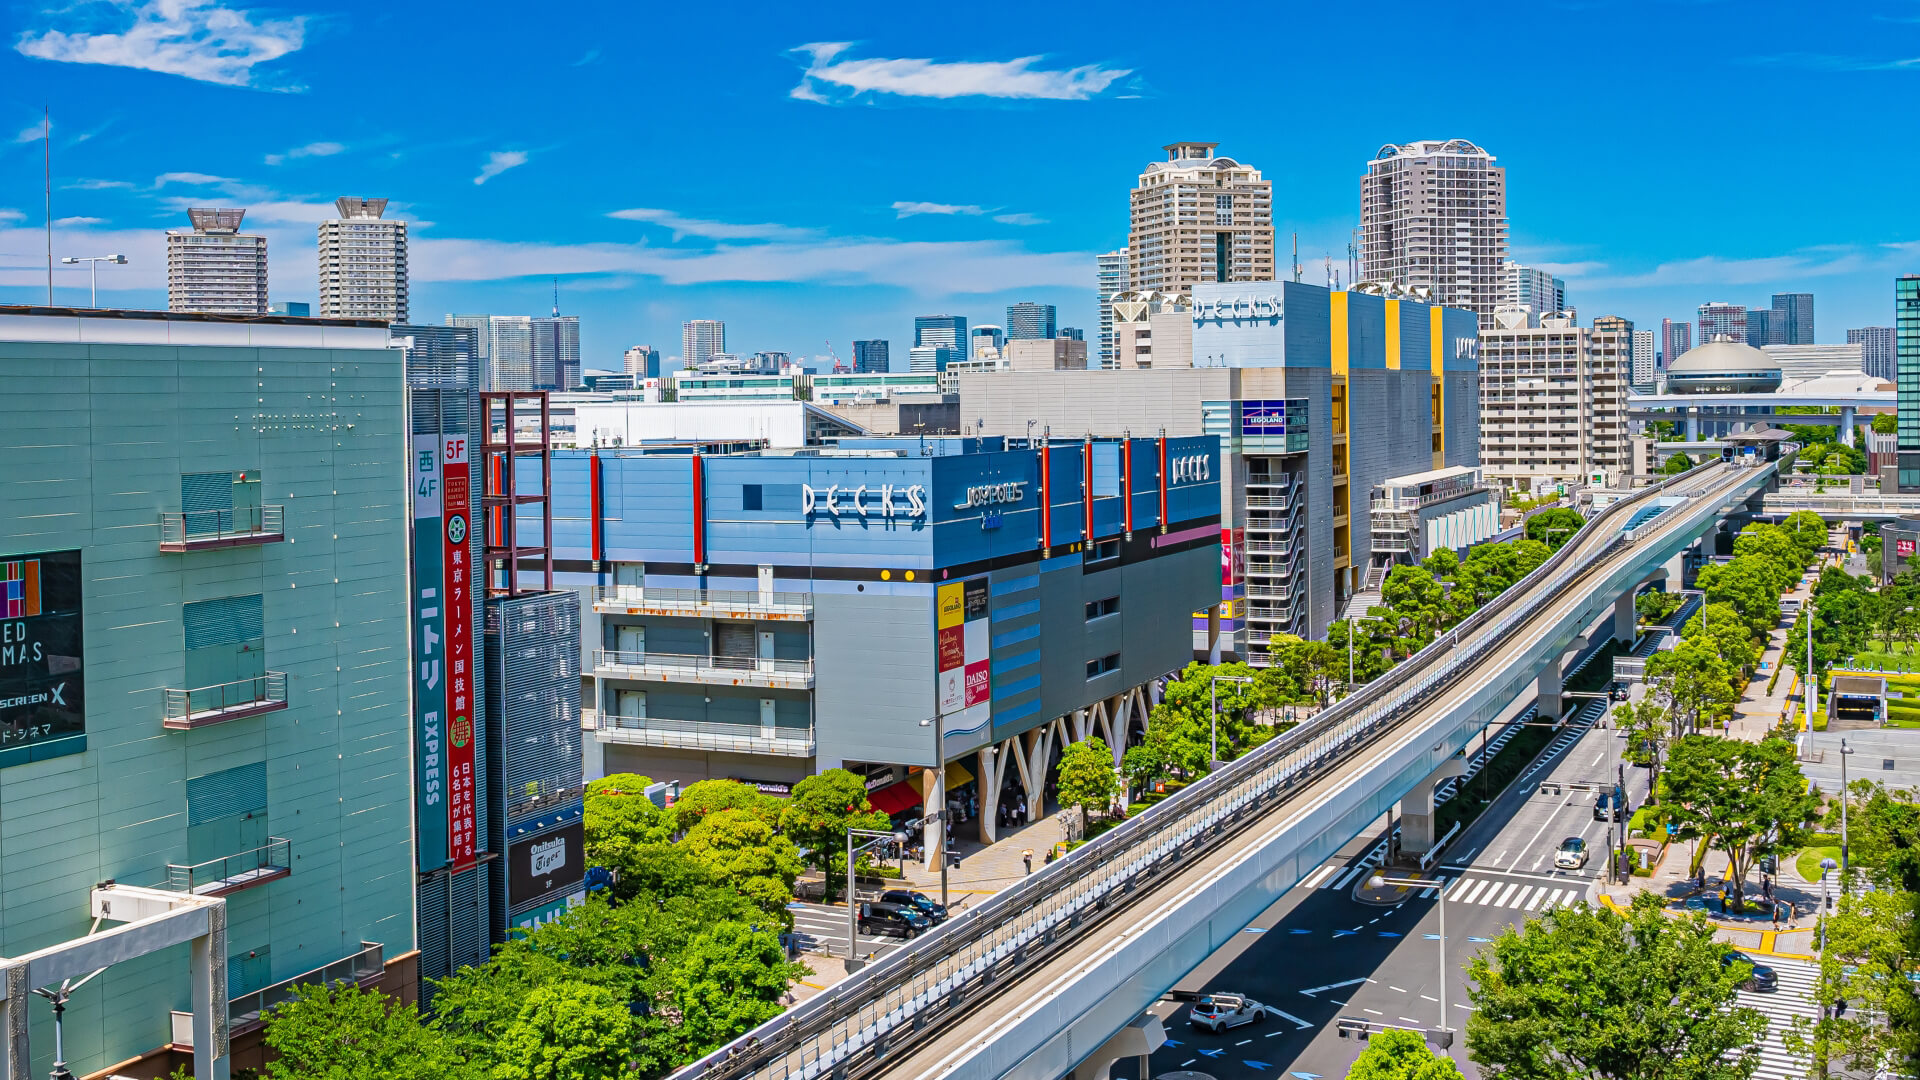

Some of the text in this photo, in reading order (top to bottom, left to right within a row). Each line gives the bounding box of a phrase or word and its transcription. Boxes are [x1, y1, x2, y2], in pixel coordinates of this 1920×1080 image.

[1195, 294, 1279, 319] DECKS
[446, 440, 465, 459] 5F
[418, 450, 434, 473] 西
[418, 477, 437, 498] 4F
[802, 483, 926, 517] DECKS
[3, 622, 26, 643] ED
[420, 587, 440, 690] ニトリ
[2, 641, 42, 666] MAS
[966, 669, 988, 686] DAISO
[424, 710, 440, 806] EXPRESS
[462, 762, 472, 856] 日本を代表する
[530, 837, 566, 855] Onitsuka
[535, 850, 561, 871] Tiger
